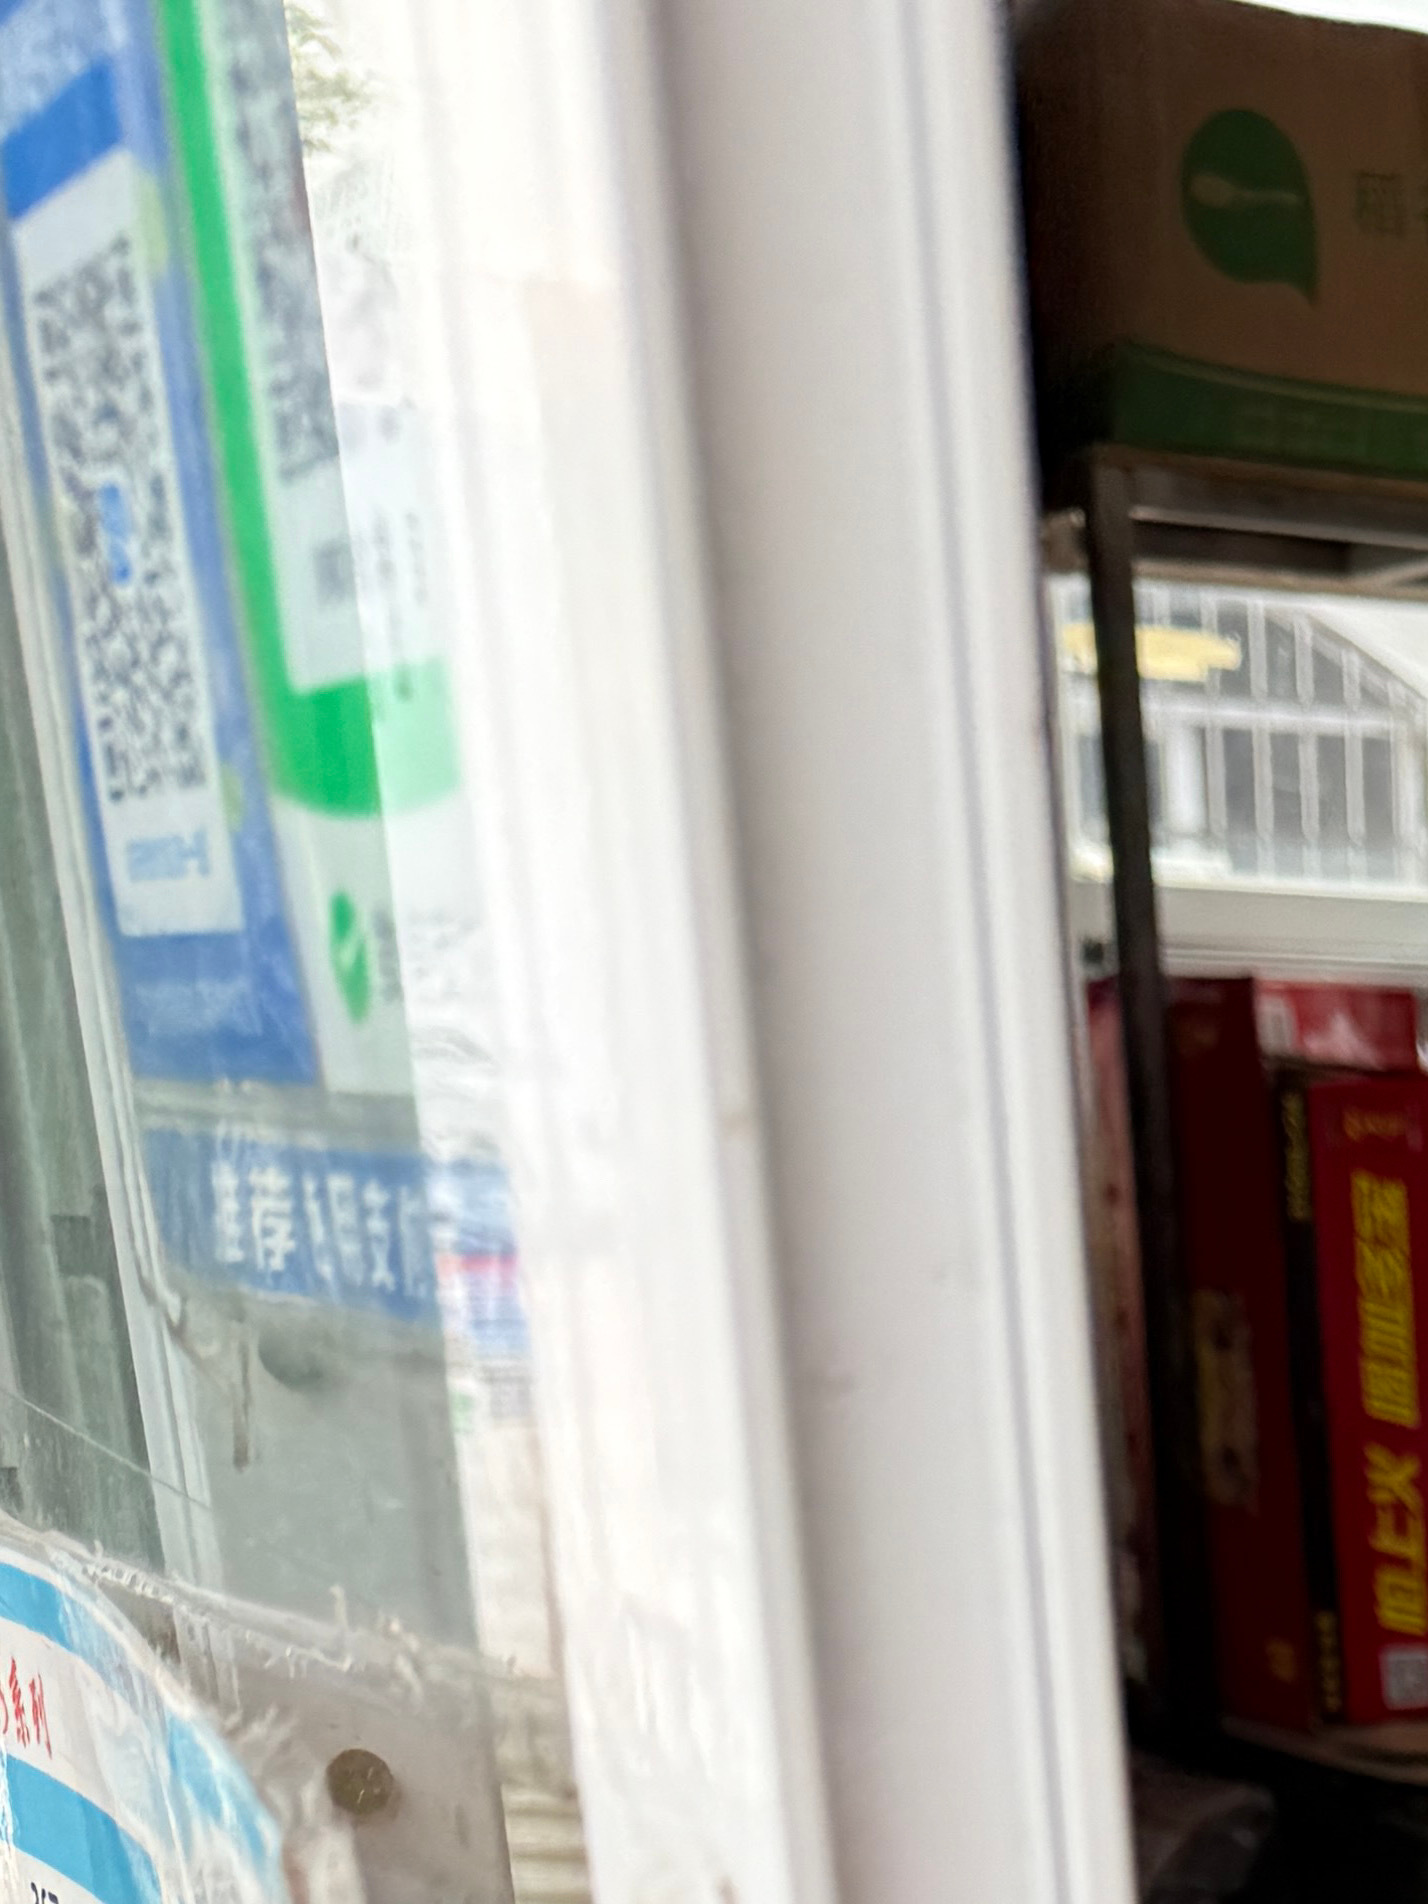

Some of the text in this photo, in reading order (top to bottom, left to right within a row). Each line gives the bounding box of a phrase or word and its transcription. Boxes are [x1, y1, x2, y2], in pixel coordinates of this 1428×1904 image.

[1351, 1170, 1420, 1430] 喝加多宝
[0, 1655, 53, 1758] 系列
